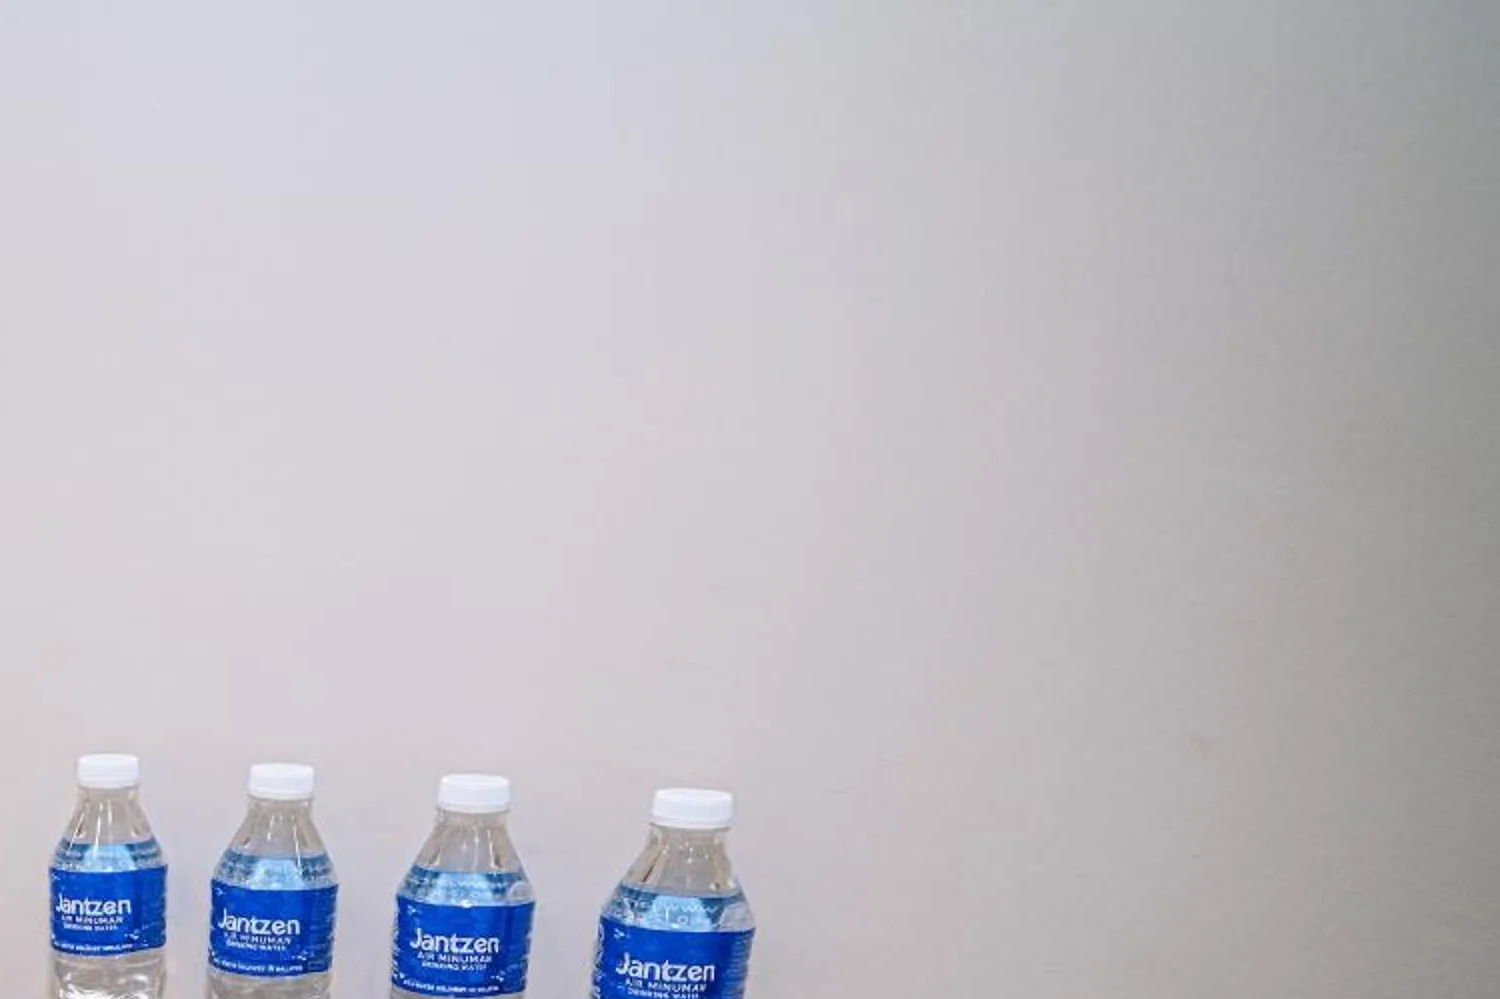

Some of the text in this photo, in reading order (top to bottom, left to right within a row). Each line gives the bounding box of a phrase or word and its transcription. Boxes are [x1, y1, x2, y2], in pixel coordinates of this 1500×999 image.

[56, 892, 131, 915] Jantzen
[218, 907, 300, 935] Jantzen
[409, 927, 500, 953] Jantzen
[615, 952, 715, 982] Jantzen
